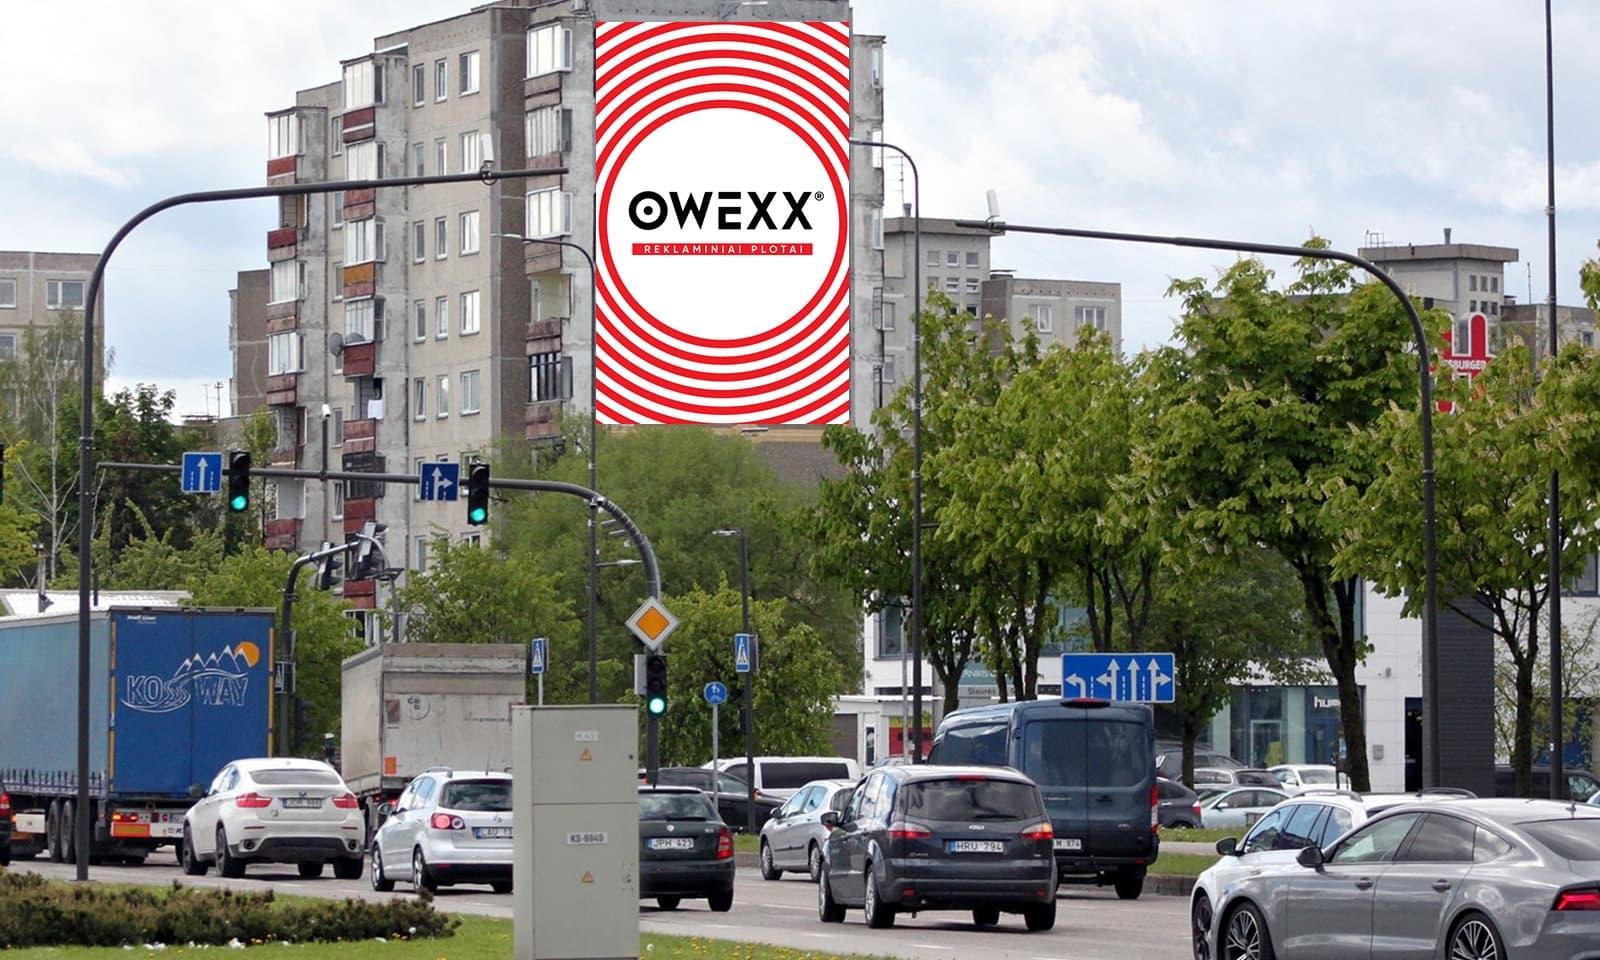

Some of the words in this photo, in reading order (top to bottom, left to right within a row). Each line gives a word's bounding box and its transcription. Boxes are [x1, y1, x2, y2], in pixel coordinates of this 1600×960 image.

[644, 244, 742, 254] REKLAMINIAI
[751, 244, 803, 254] PLOTAI
[957, 841, 978, 851] HRU
[983, 841, 1003, 851] 794
